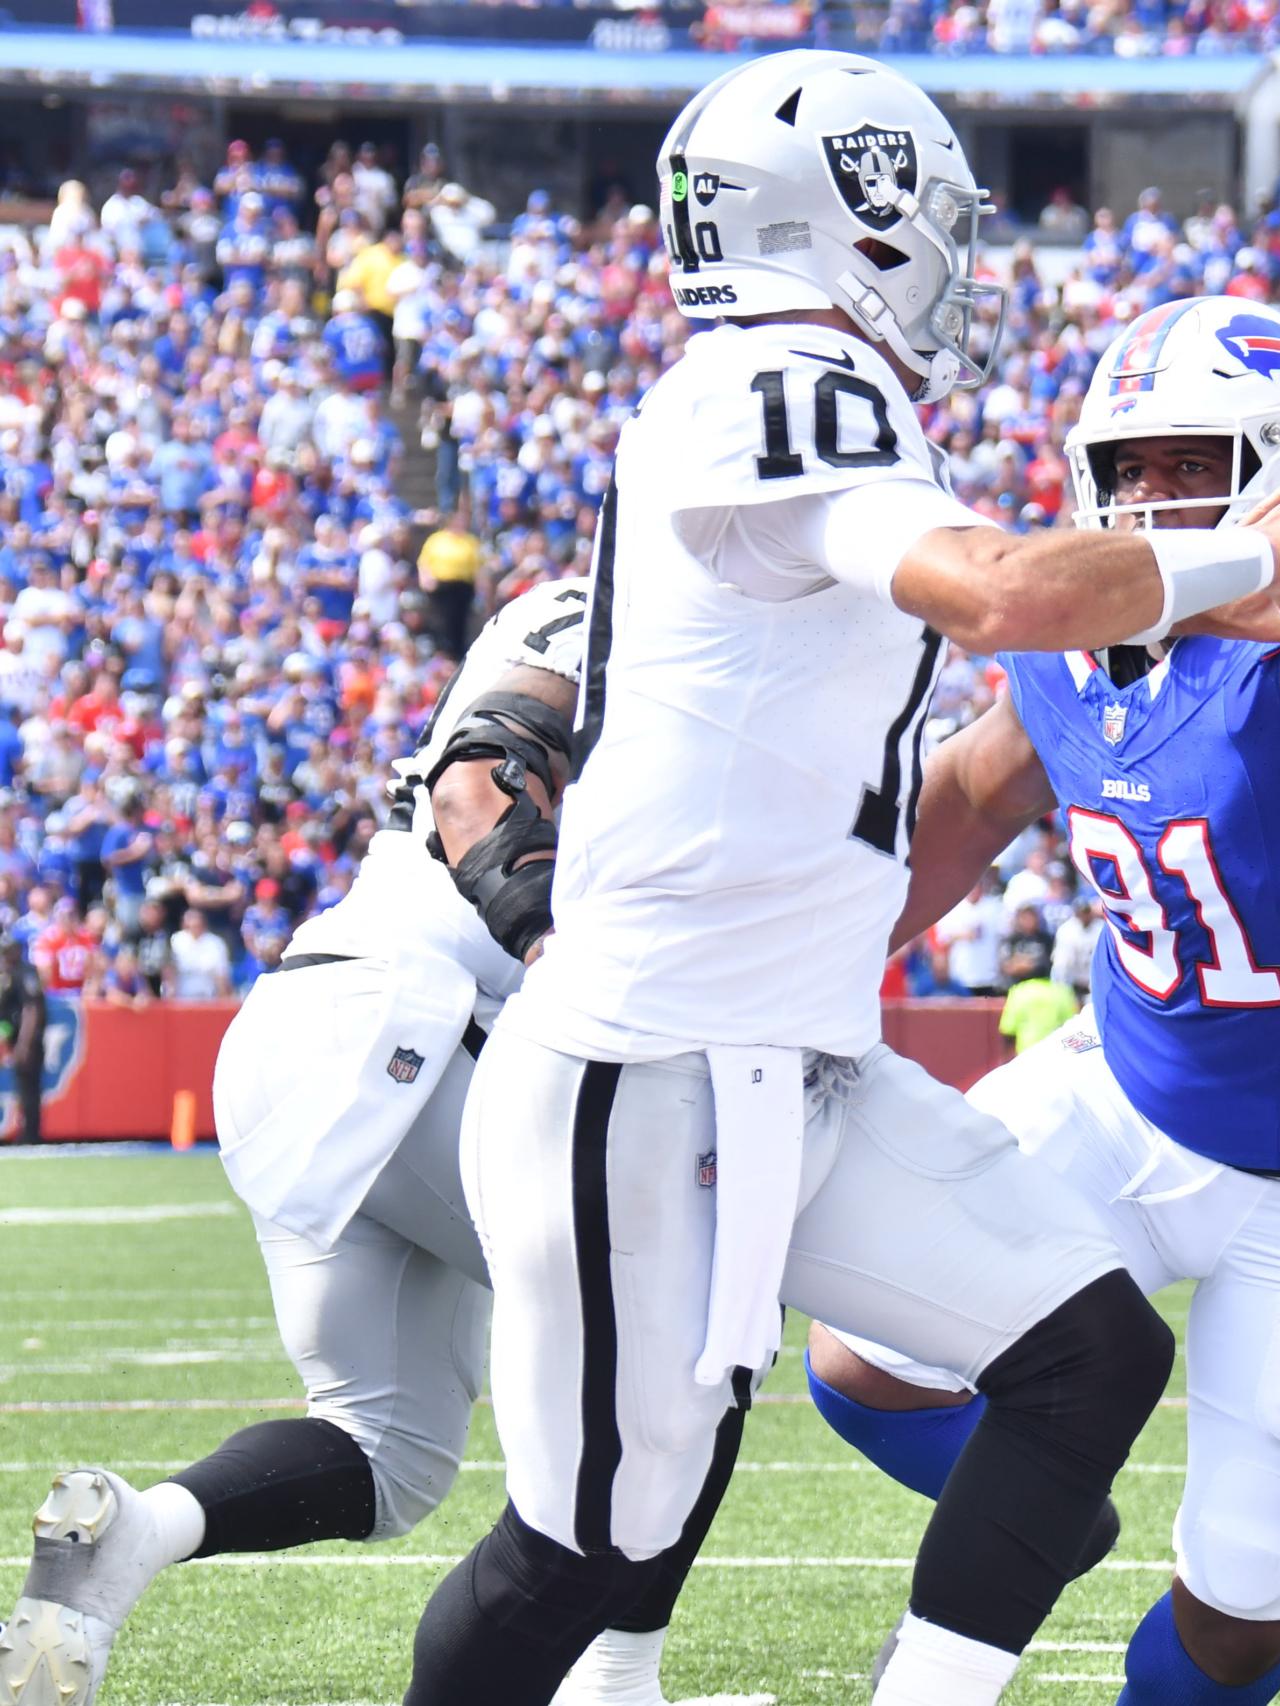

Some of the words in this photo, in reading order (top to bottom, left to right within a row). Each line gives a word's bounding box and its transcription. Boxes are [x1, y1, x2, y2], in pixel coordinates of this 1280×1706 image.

[832, 133, 907, 150] RAIDERS
[696, 178, 717, 194] AL
[672, 285, 738, 306] AIDERS
[750, 370, 902, 480] 10
[1101, 780, 1151, 802] BILLS
[391, 1060, 415, 1080] NFL
